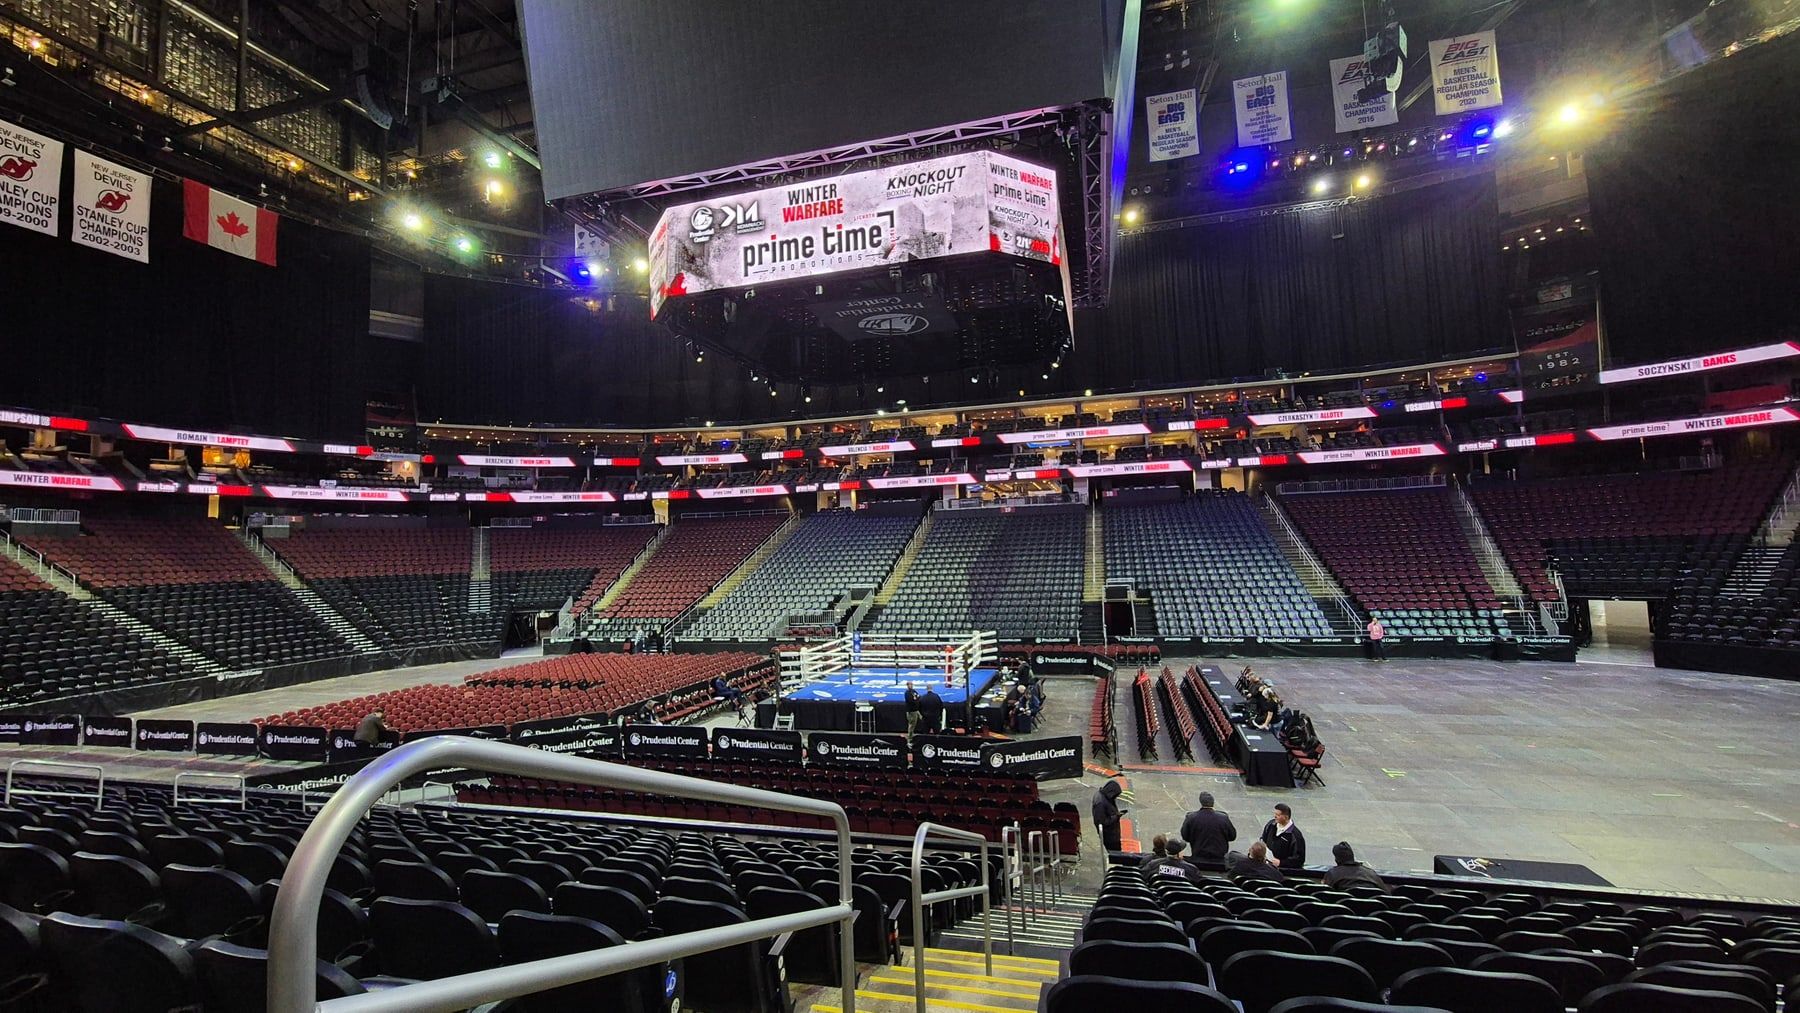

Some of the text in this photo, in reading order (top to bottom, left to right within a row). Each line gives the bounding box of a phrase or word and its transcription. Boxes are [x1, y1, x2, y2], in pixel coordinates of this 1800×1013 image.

[1446, 39, 1480, 52] BIG
[1442, 46, 1489, 61] EAST
[1342, 71, 1365, 80] EA
[1454, 66, 1476, 74] MEN'S
[1237, 74, 1282, 88] Seton Hall
[1436, 78, 1498, 94] REGULAR SEASON
[1444, 74, 1488, 85] BASKETBALL
[1256, 85, 1275, 97] BIG
[1446, 88, 1489, 100] CHAMPIONS
[1150, 91, 1192, 105] Seton Hall
[1246, 95, 1275, 109] EAST
[1459, 98, 1477, 106] 2020
[1167, 102, 1184, 112] BIG
[1345, 106, 1386, 118] CHAMPIONS
[1158, 112, 1186, 124] EAST
[0, 128, 46, 150] EW JERSEY
[1151, 138, 1176, 146] REGULAR
[1157, 131, 1190, 140] BASKETBALL
[1159, 143, 1190, 152] CHAMPIONS
[91, 162, 138, 184] NEW JERSEY
[887, 166, 965, 190] KNOCKOUT
[990, 163, 1052, 190] WINTER WARFARE
[94, 172, 133, 192] DEVILS
[0, 182, 57, 206] NLEY CUP
[788, 184, 837, 205] WINTER
[886, 181, 954, 198] BOXING NIGHT
[994, 184, 1022, 198] prime
[1025, 189, 1046, 206] time
[0, 195, 52, 218] AMPIONS
[783, 198, 844, 222] WARFARE
[995, 206, 1030, 218] KNOCKOUT
[0, 208, 48, 228] 9-2000
[77, 206, 148, 236] STANLEY CUP
[1007, 216, 1024, 224] NIGHT
[80, 219, 143, 246] CHAMPIONS
[82, 232, 140, 256] 2002-2003
[743, 234, 814, 277] prime
[822, 224, 882, 256] time
[847, 296, 902, 308] Center
[836, 302, 924, 318] Prudential
[1539, 358, 1581, 370] 1982
[1638, 354, 1736, 376] SOCZYNSKI BANKS
[1622, 412, 1772, 436] prime time WINTER WARFARE
[176, 432, 249, 446] ROMAIN LAMPTEY
[1390, 447, 1422, 456] WARFARE
[14, 474, 92, 486] WINTER WARFARE
[1045, 656, 1088, 665] Prudential Center
[34, 722, 58, 730] Prudential
[93, 728, 128, 736] Prudential Center
[148, 732, 189, 740] Prudential Center
[208, 734, 254, 744] Prudential Center
[274, 734, 320, 744] Prudential Center
[642, 736, 700, 746] Prudential Center
[542, 736, 614, 752] Prudential Center
[731, 738, 794, 750] Prudential Center
[831, 744, 898, 756] Prudential Center
[937, 748, 981, 758] Prudential
[1006, 748, 1076, 763] Prudential Center
[278, 775, 338, 792] Prudential
[1158, 864, 1185, 878] SECURITY
